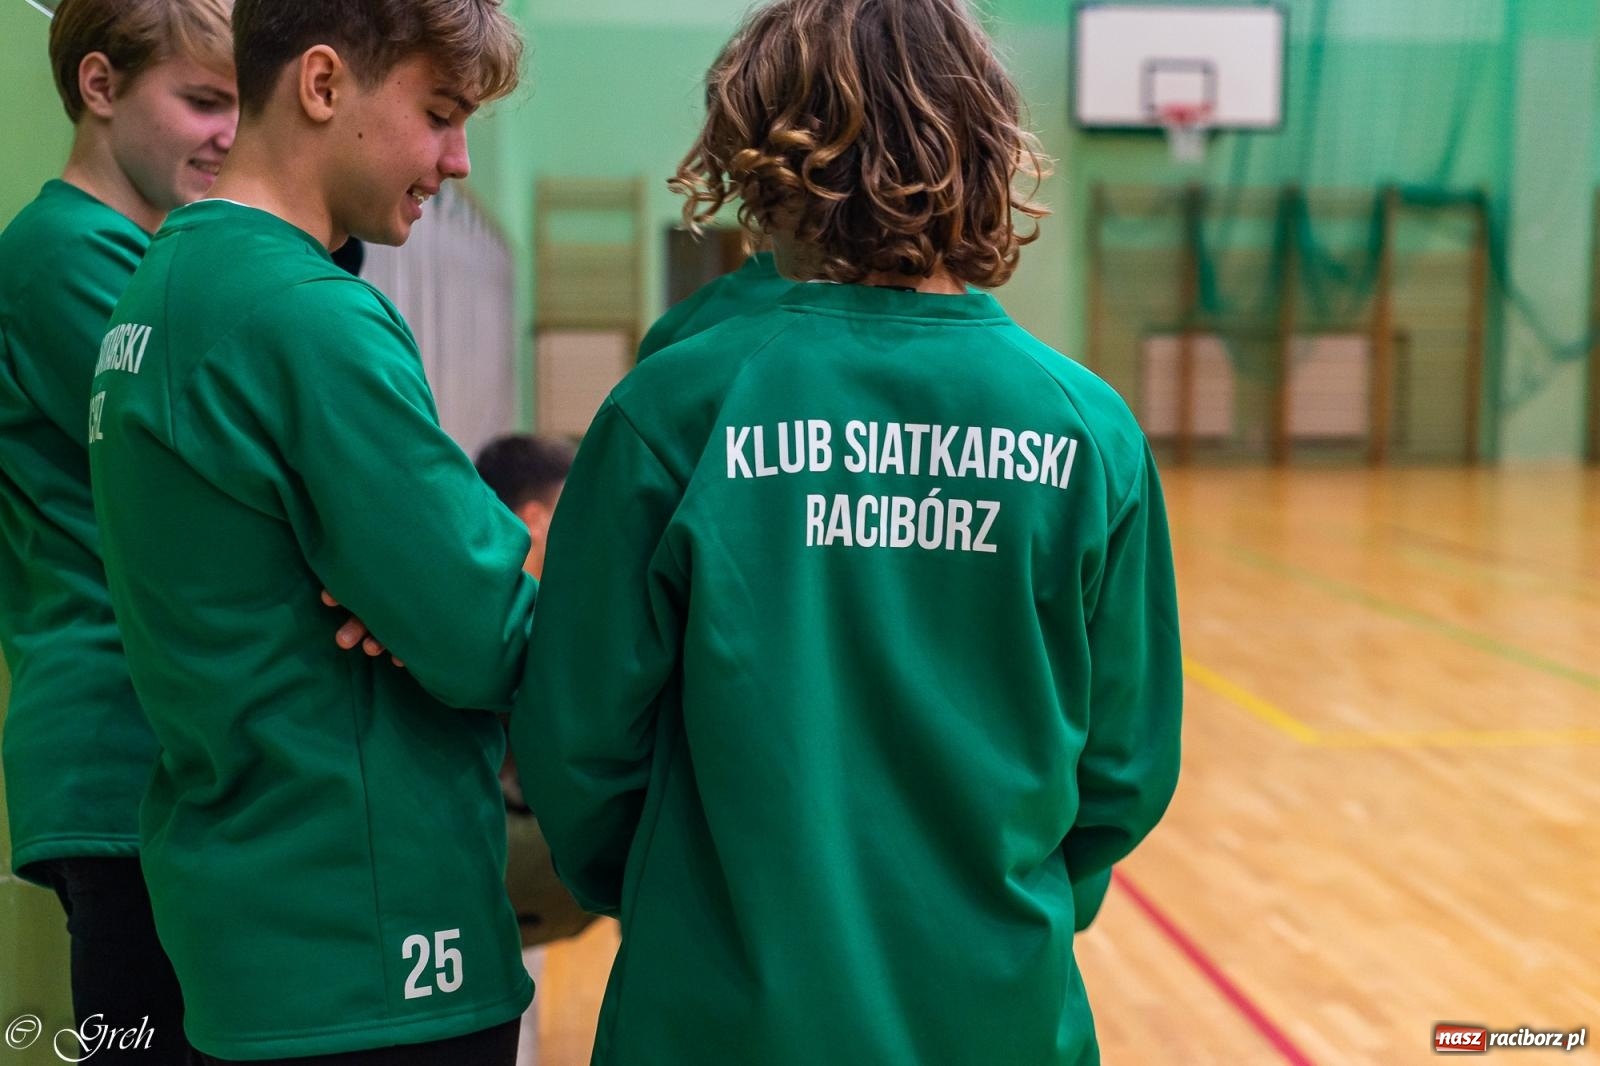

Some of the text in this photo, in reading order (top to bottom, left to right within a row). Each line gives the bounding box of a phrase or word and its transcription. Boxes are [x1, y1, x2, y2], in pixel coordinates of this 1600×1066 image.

[726, 419, 1078, 489] KLUB SIATKARSKI
[806, 488, 1001, 552] RACIBÓRZ
[402, 928, 463, 1000] 25
